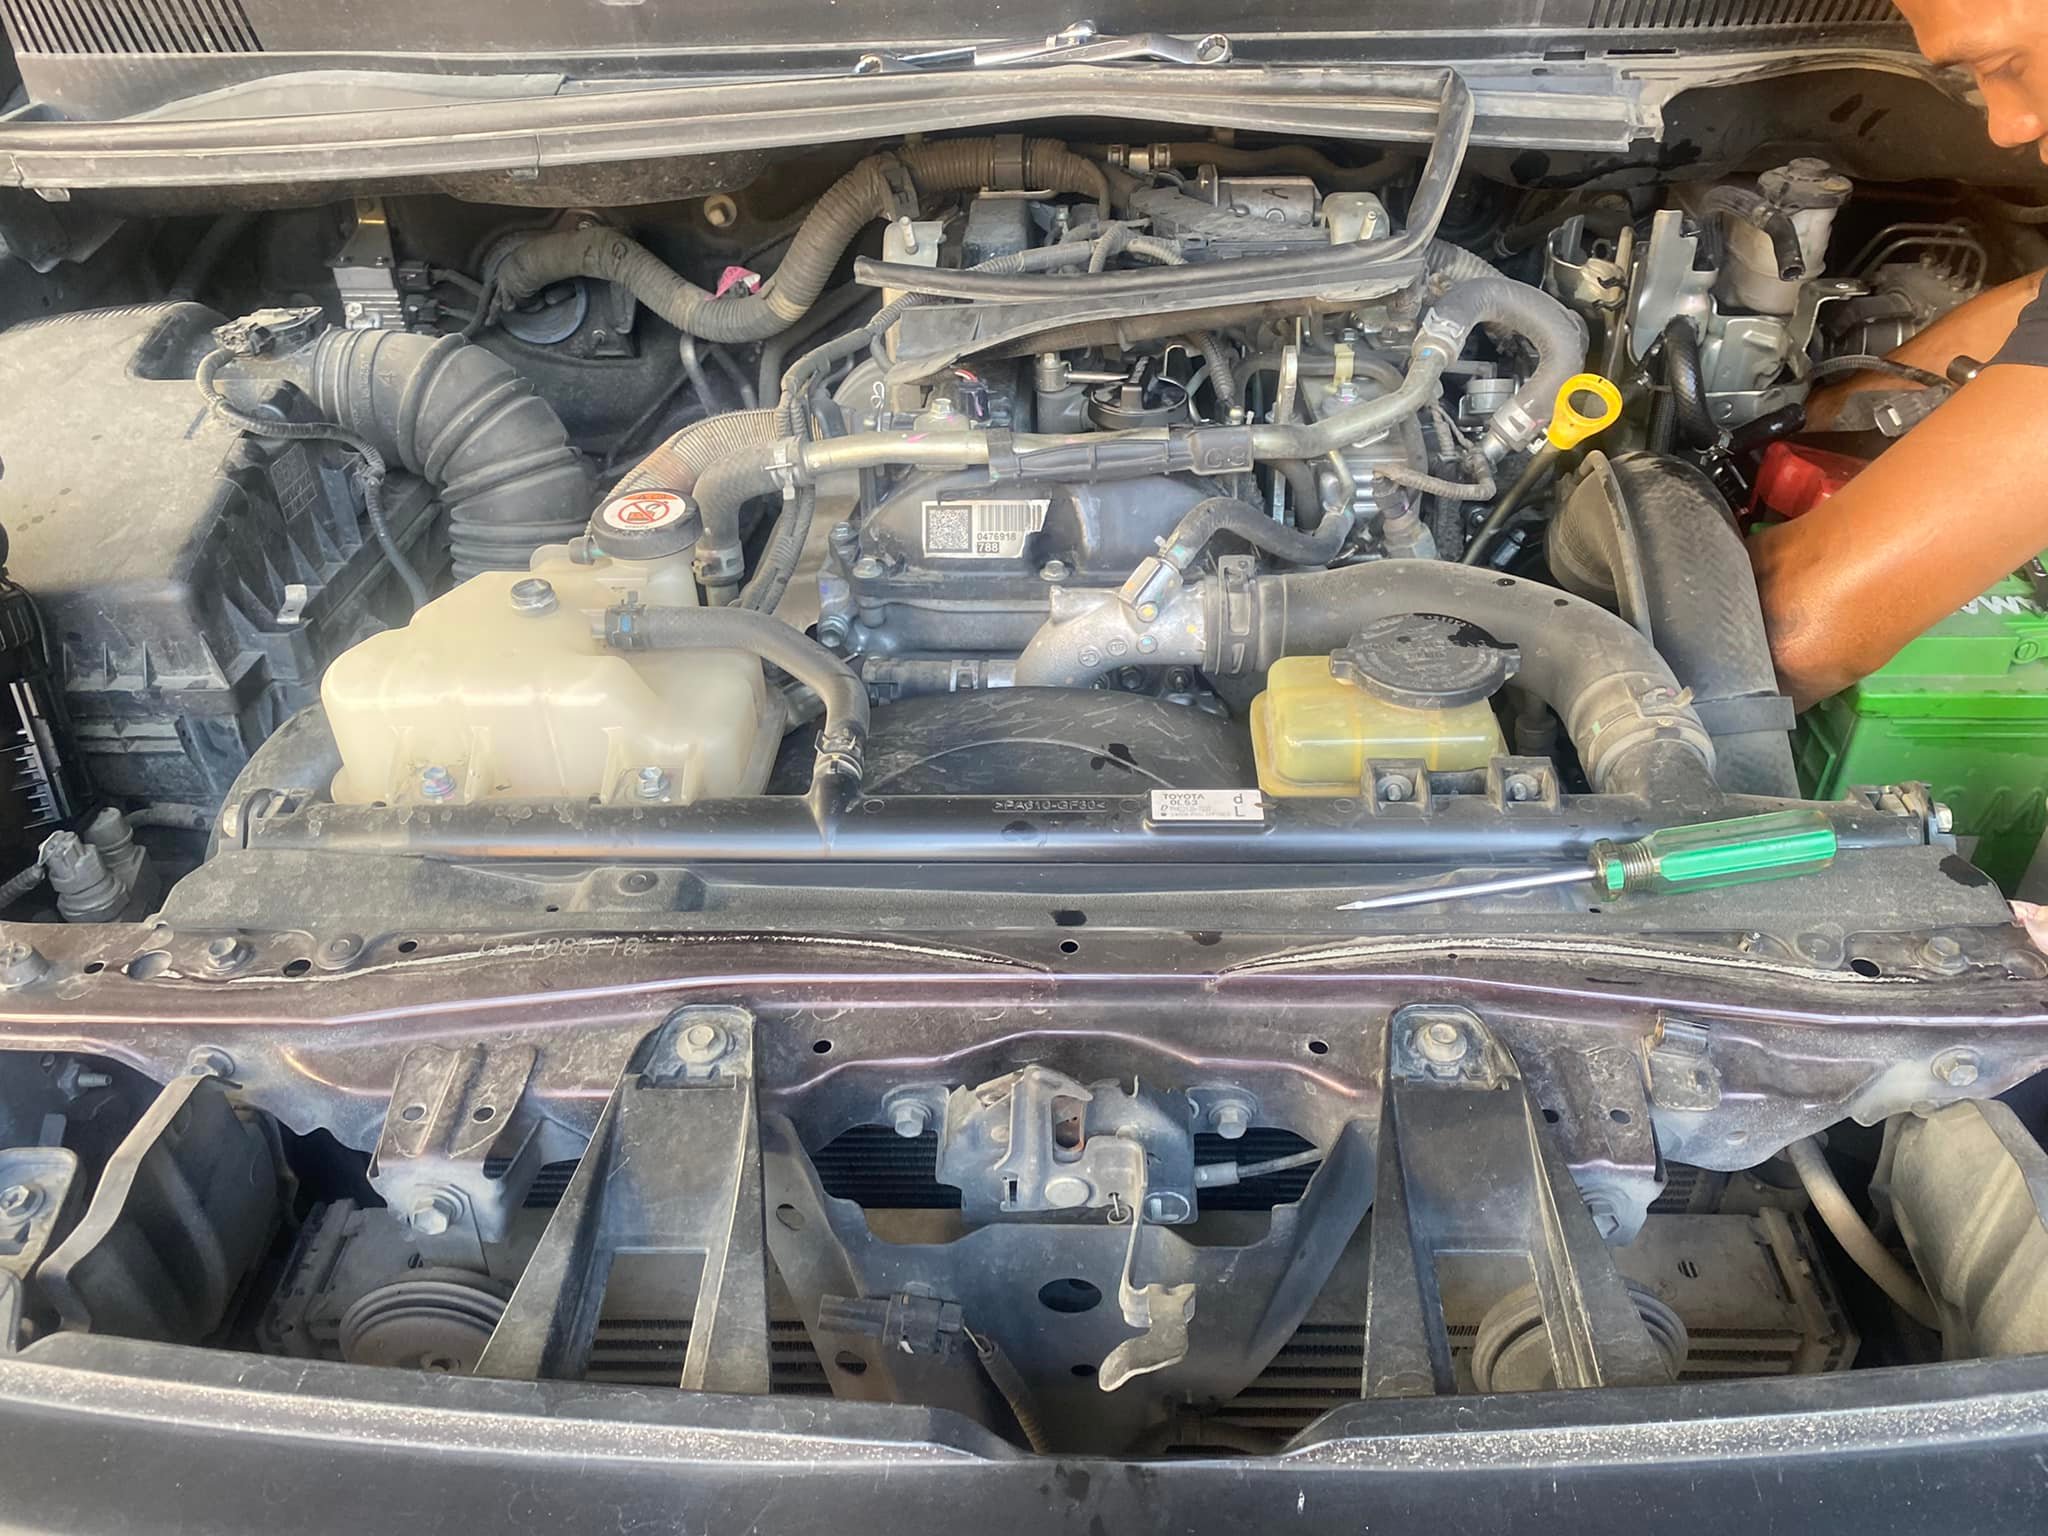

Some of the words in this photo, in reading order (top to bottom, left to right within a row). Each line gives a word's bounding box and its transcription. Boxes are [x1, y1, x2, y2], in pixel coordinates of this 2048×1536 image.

[978, 542, 998, 552] 788
[1162, 793, 1206, 801] TOYOTA
[1151, 1198, 1180, 1221] L
